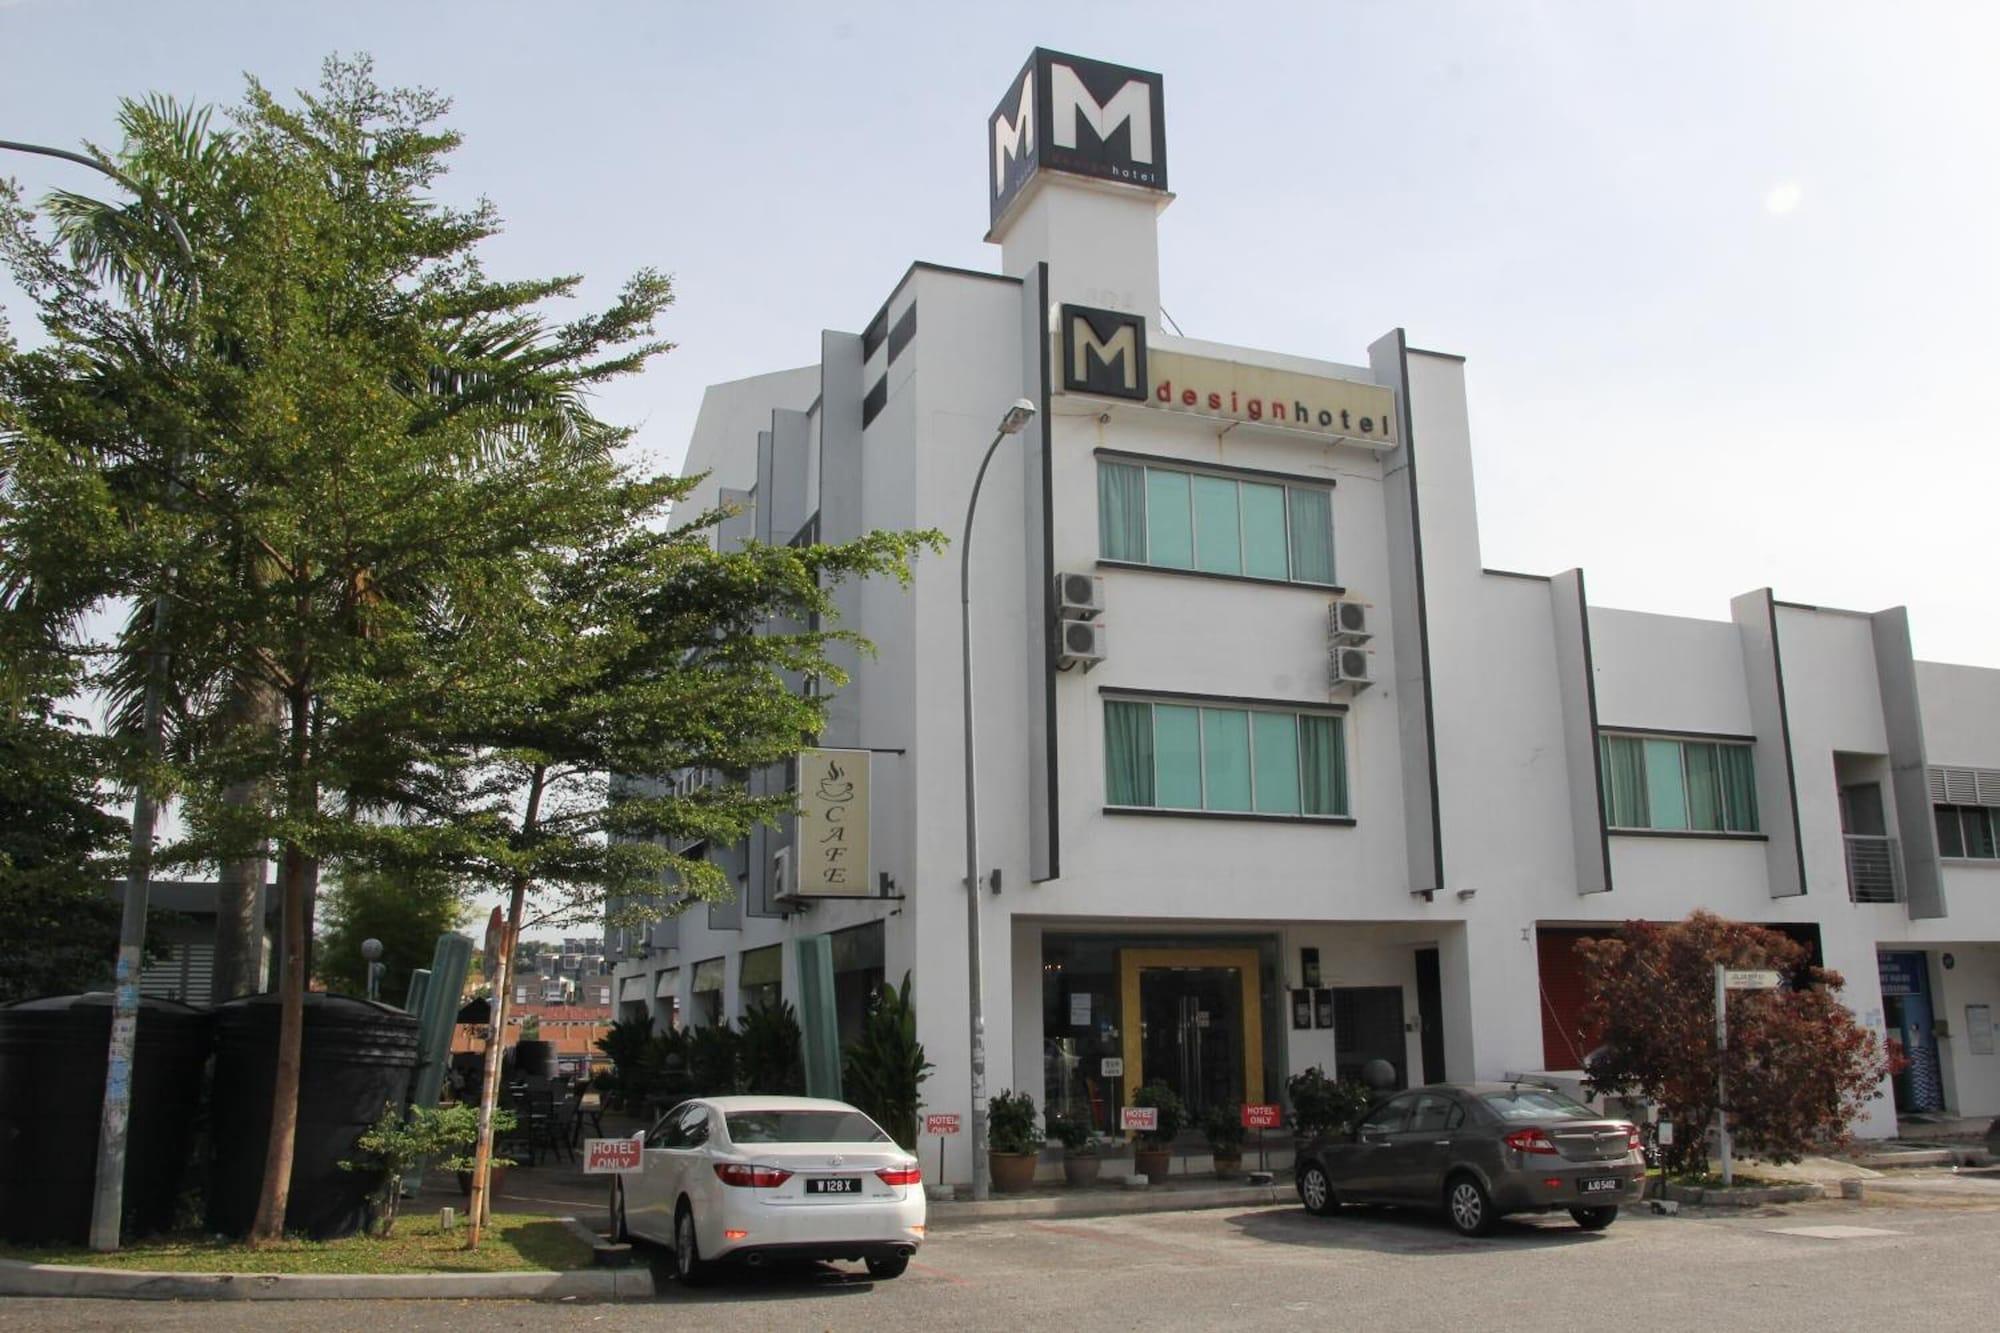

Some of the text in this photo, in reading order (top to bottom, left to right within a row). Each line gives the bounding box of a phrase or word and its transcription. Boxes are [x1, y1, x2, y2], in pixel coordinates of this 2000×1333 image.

[1052, 64, 1152, 164] M
[995, 70, 1034, 199] M
[1073, 316, 1137, 389] M
[820, 806, 847, 884] CAFE
[1126, 1109, 1153, 1118] HOTEL
[1247, 1106, 1274, 1116] HOTEL
[928, 1116, 956, 1125] HOTEL
[1249, 1116, 1272, 1125] ONLY
[592, 1142, 635, 1154] HOTEL
[596, 1157, 631, 1169] ONLY
[817, 1180, 852, 1192] W 128 X
